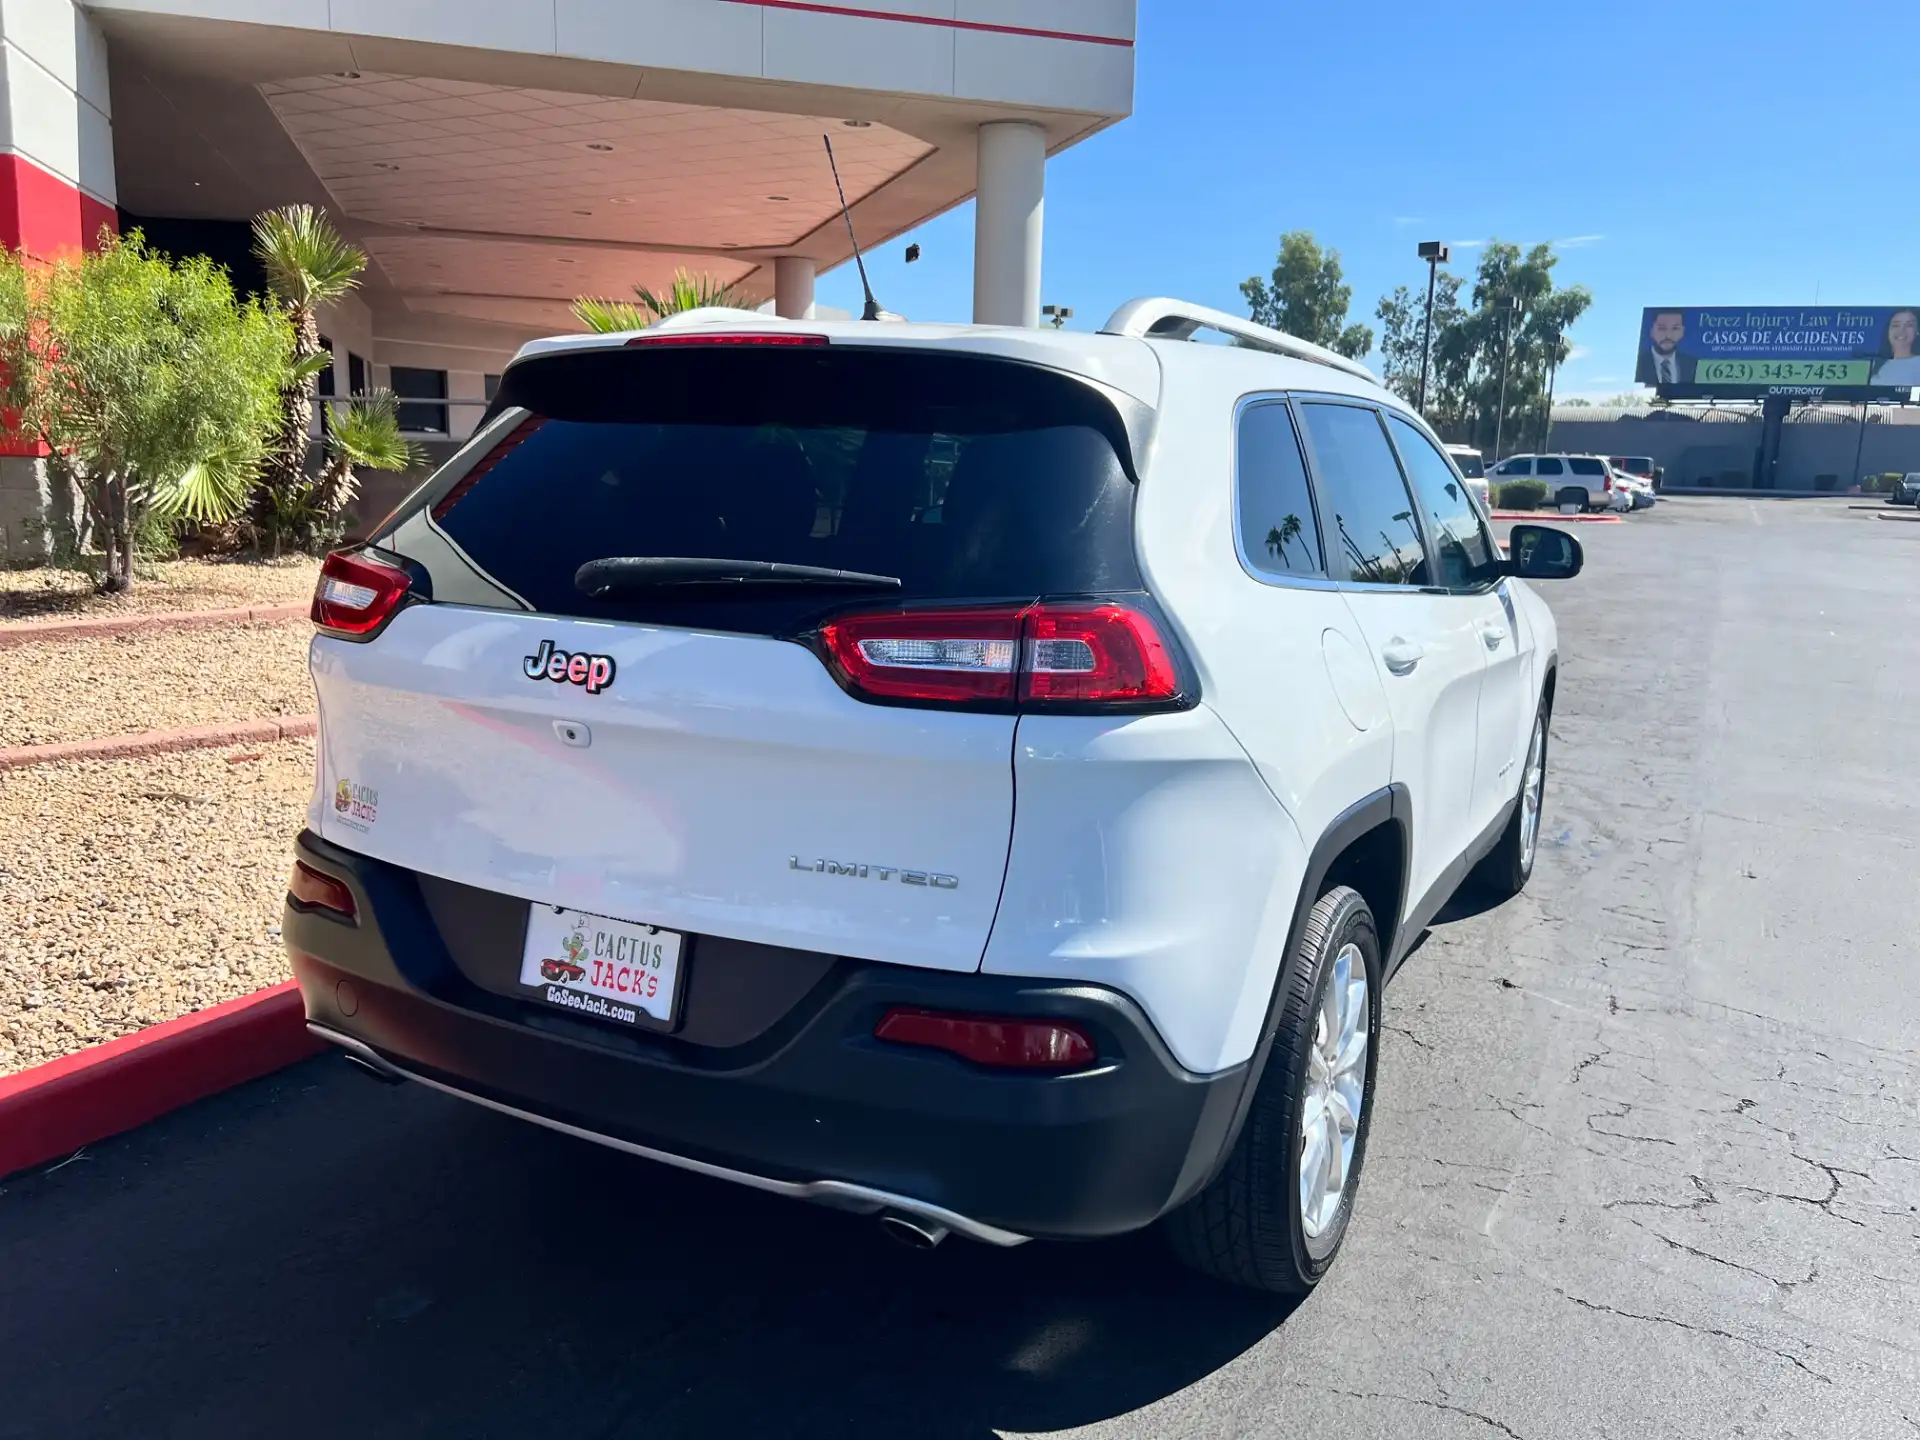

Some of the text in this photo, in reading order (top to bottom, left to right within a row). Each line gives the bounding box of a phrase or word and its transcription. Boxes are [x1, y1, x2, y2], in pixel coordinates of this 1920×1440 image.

[1699, 312, 1875, 330] Perez Injury Law Firm
[1702, 331, 1865, 345] CASOS DE ACCIDENTES
[1705, 363, 1849, 382] (623) 343-7453
[523, 639, 617, 695] Jeep
[789, 855, 959, 889] LIMITED
[594, 931, 663, 969] CACTUS
[546, 985, 636, 1024] GoSeeJack.com
